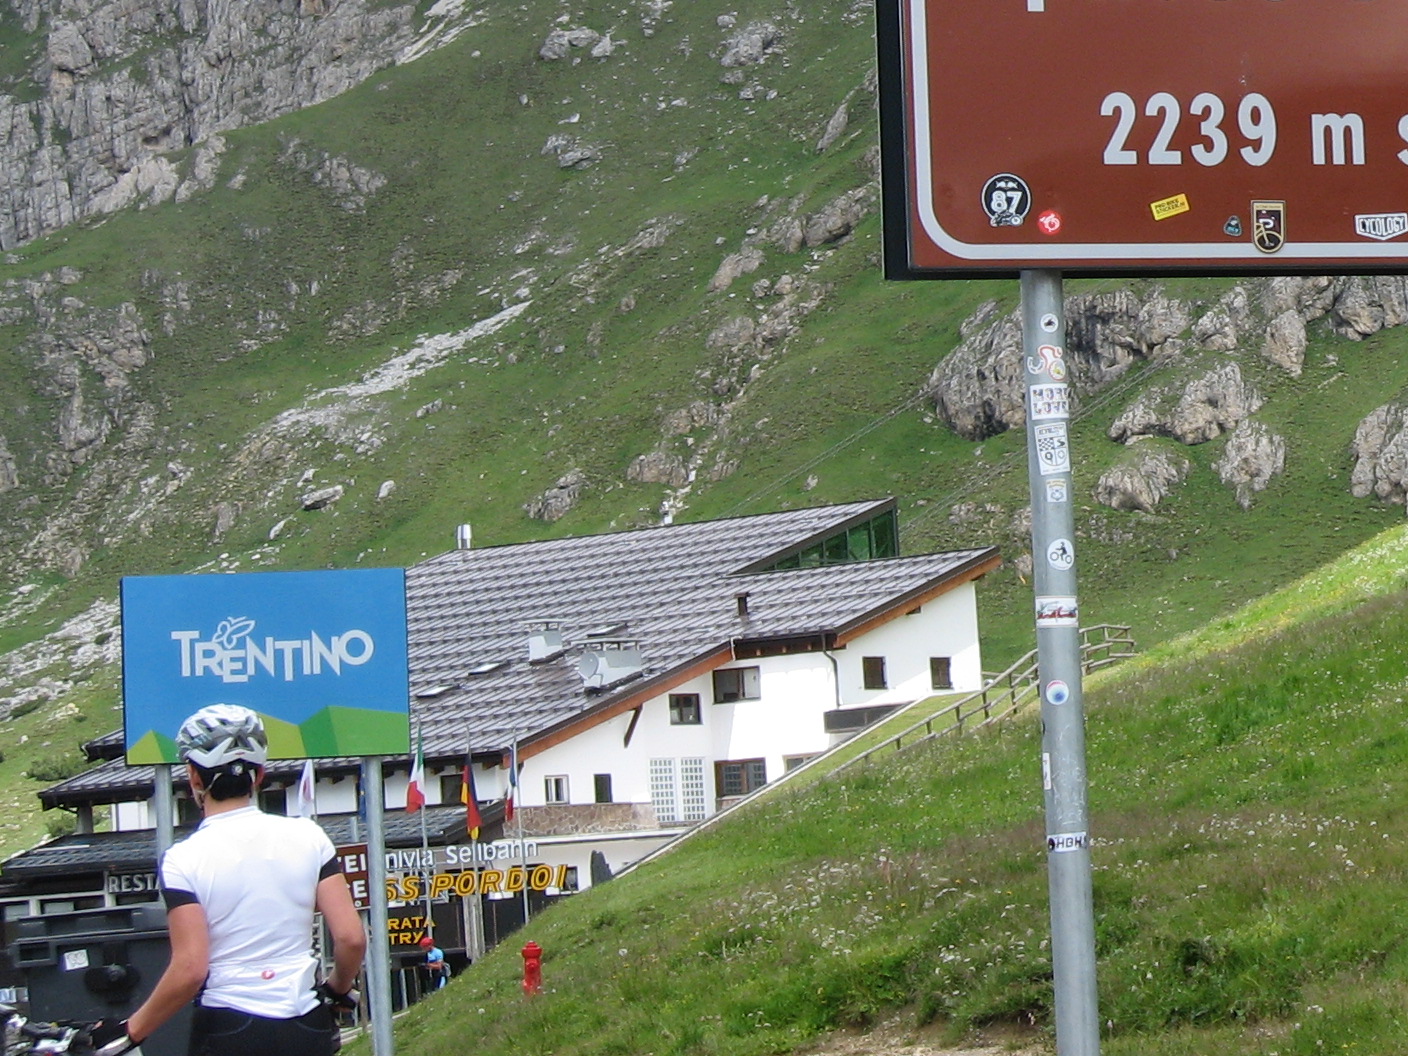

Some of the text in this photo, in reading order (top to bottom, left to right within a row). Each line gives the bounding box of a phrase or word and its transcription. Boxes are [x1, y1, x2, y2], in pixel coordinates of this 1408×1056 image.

[1101, 92, 1276, 166] 2239
[1312, 114, 1364, 164] m
[991, 190, 1022, 213] 87
[170, 629, 375, 683] TRENTINO
[386, 840, 538, 869] nivia Selbahn
[431, 863, 569, 899] PORDOI
